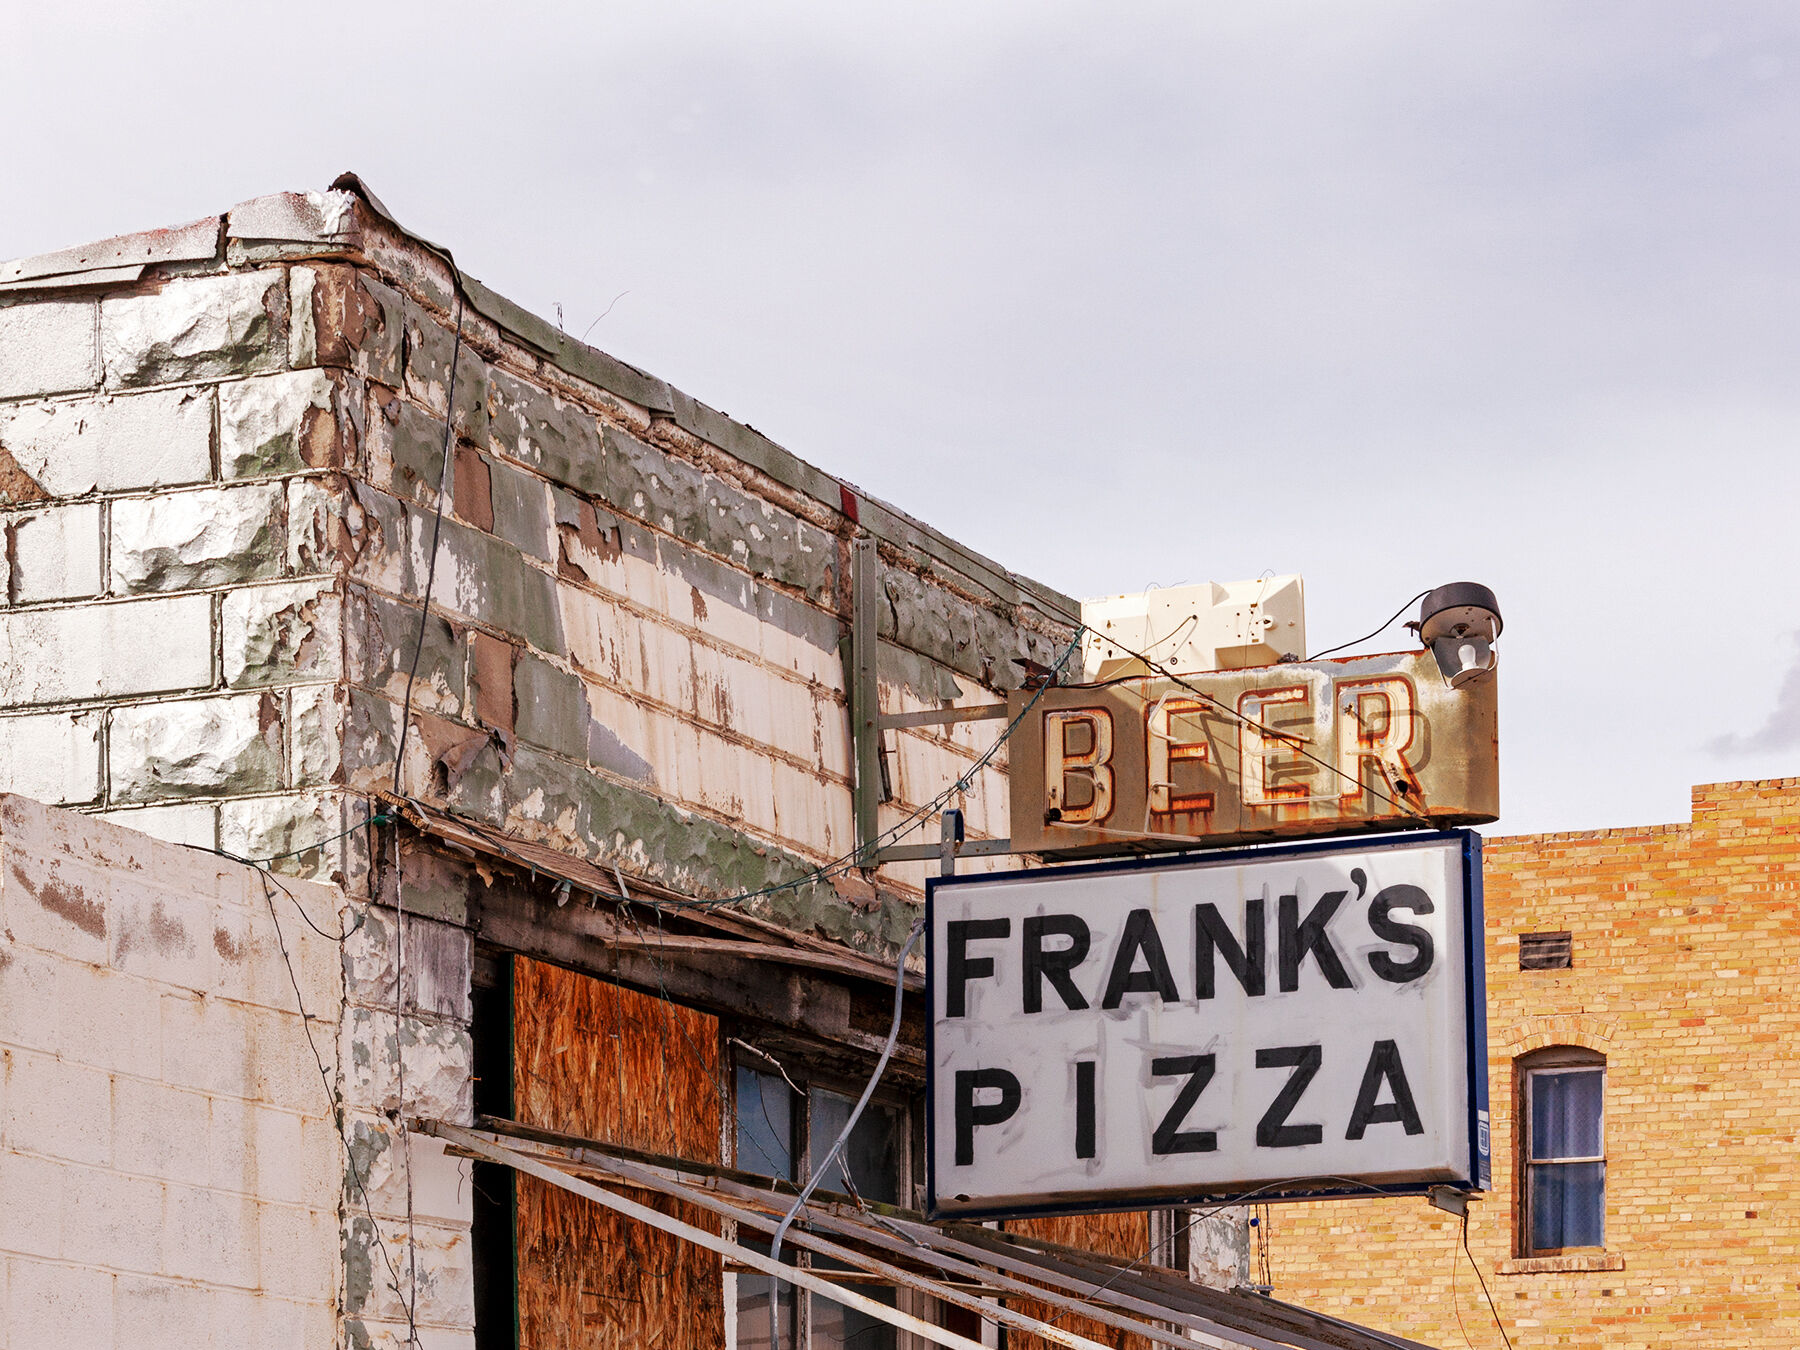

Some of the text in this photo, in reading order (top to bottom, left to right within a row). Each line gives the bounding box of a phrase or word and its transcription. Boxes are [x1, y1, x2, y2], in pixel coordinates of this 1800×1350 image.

[1043, 675, 1424, 827] BEER
[945, 867, 1435, 1018] FRANK'S
[954, 1039, 1425, 1167] PIZZA
